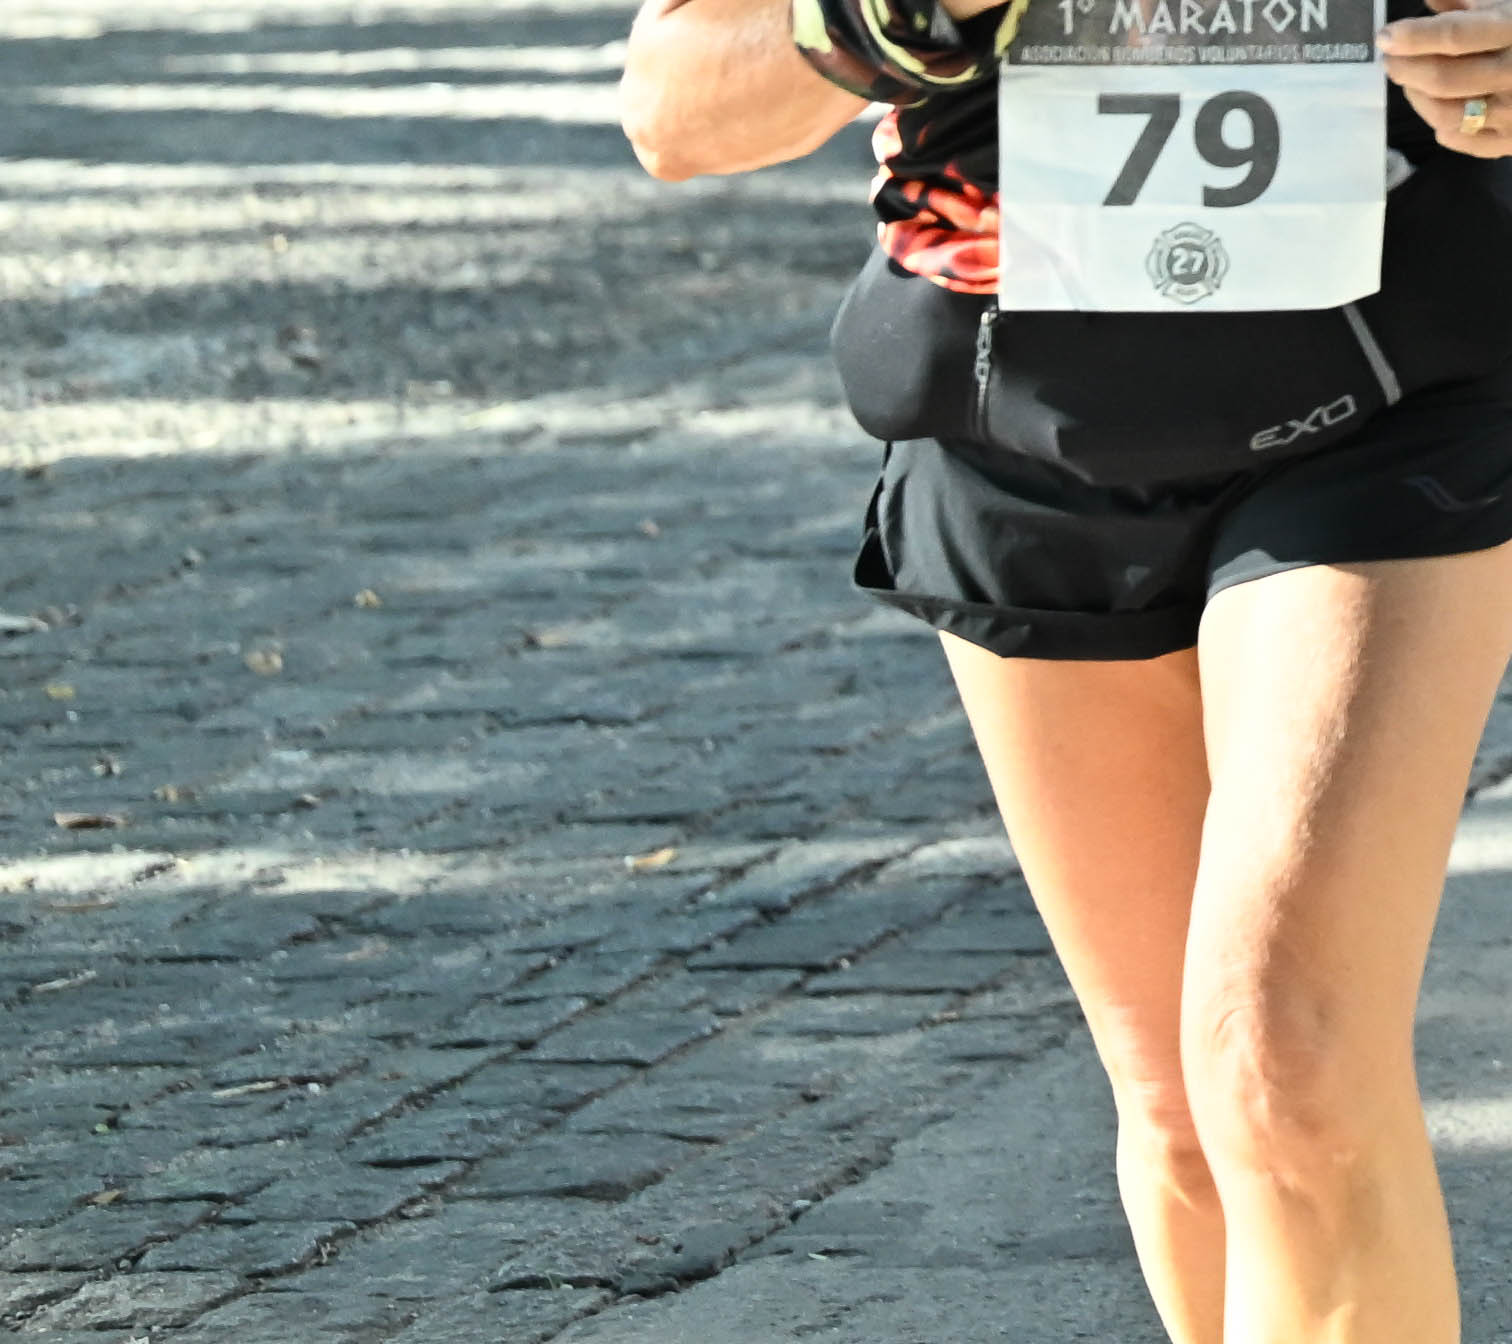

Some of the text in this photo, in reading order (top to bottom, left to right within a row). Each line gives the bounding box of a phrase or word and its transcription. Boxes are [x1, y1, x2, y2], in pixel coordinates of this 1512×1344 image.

[1096, 89, 1281, 208] 79
[1171, 247, 1204, 276] 27
[1249, 394, 1358, 452] EXO
